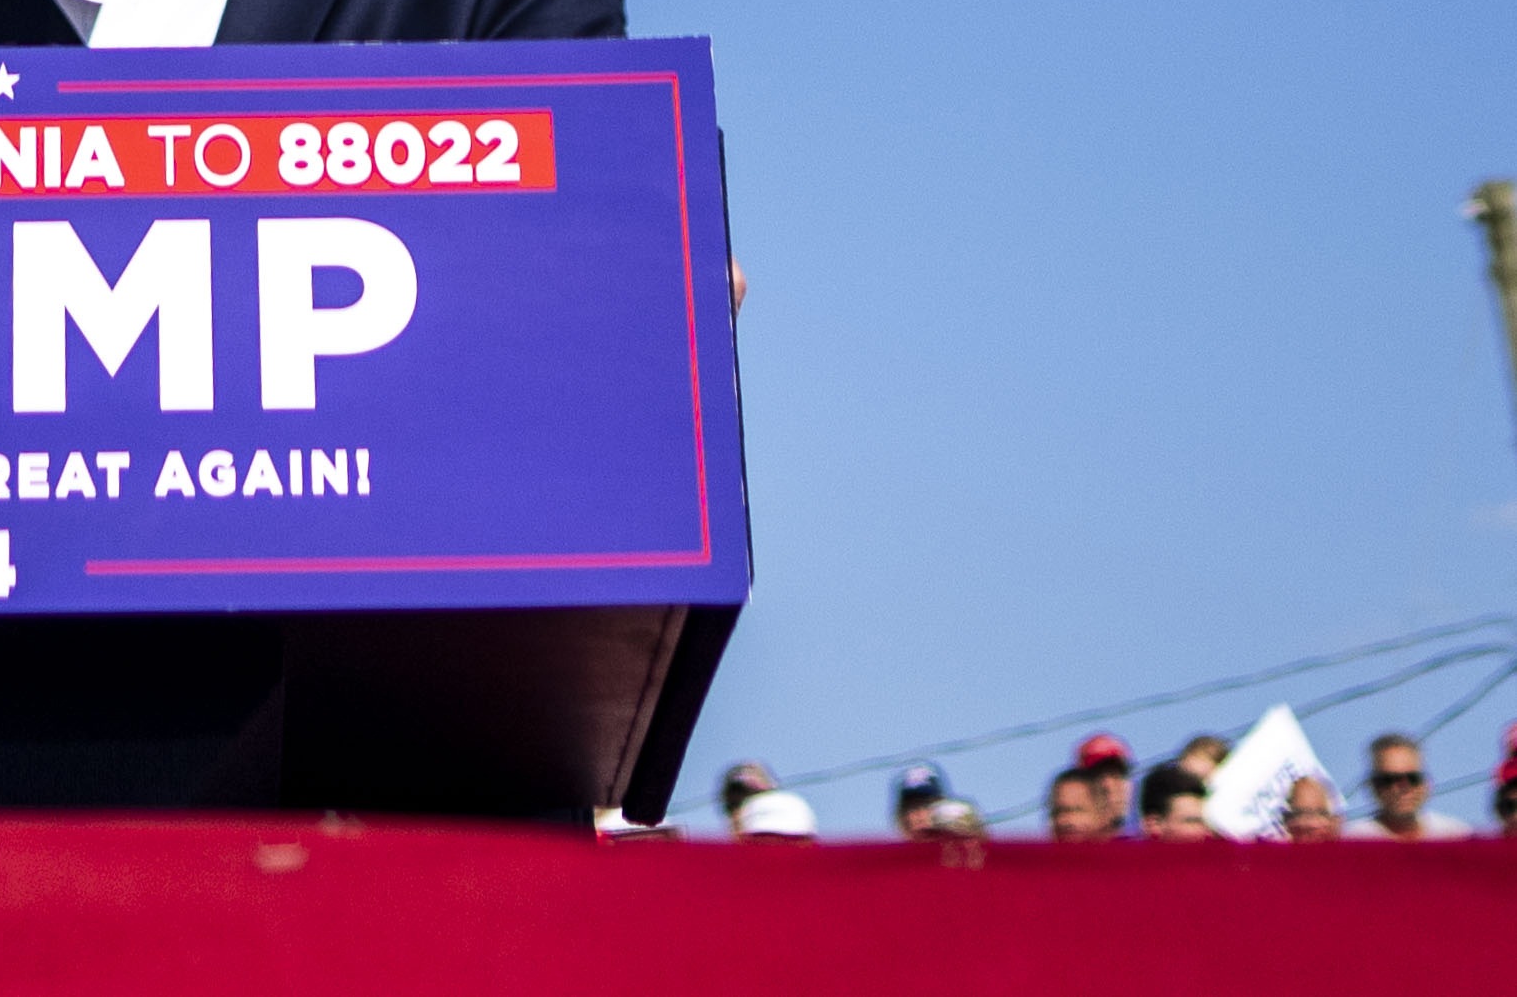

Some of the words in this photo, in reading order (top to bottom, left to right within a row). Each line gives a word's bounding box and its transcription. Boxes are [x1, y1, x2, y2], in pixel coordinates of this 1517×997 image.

[147, 123, 251, 187] TO
[277, 119, 521, 186] 88022
[154, 448, 371, 498] AGAIN!
